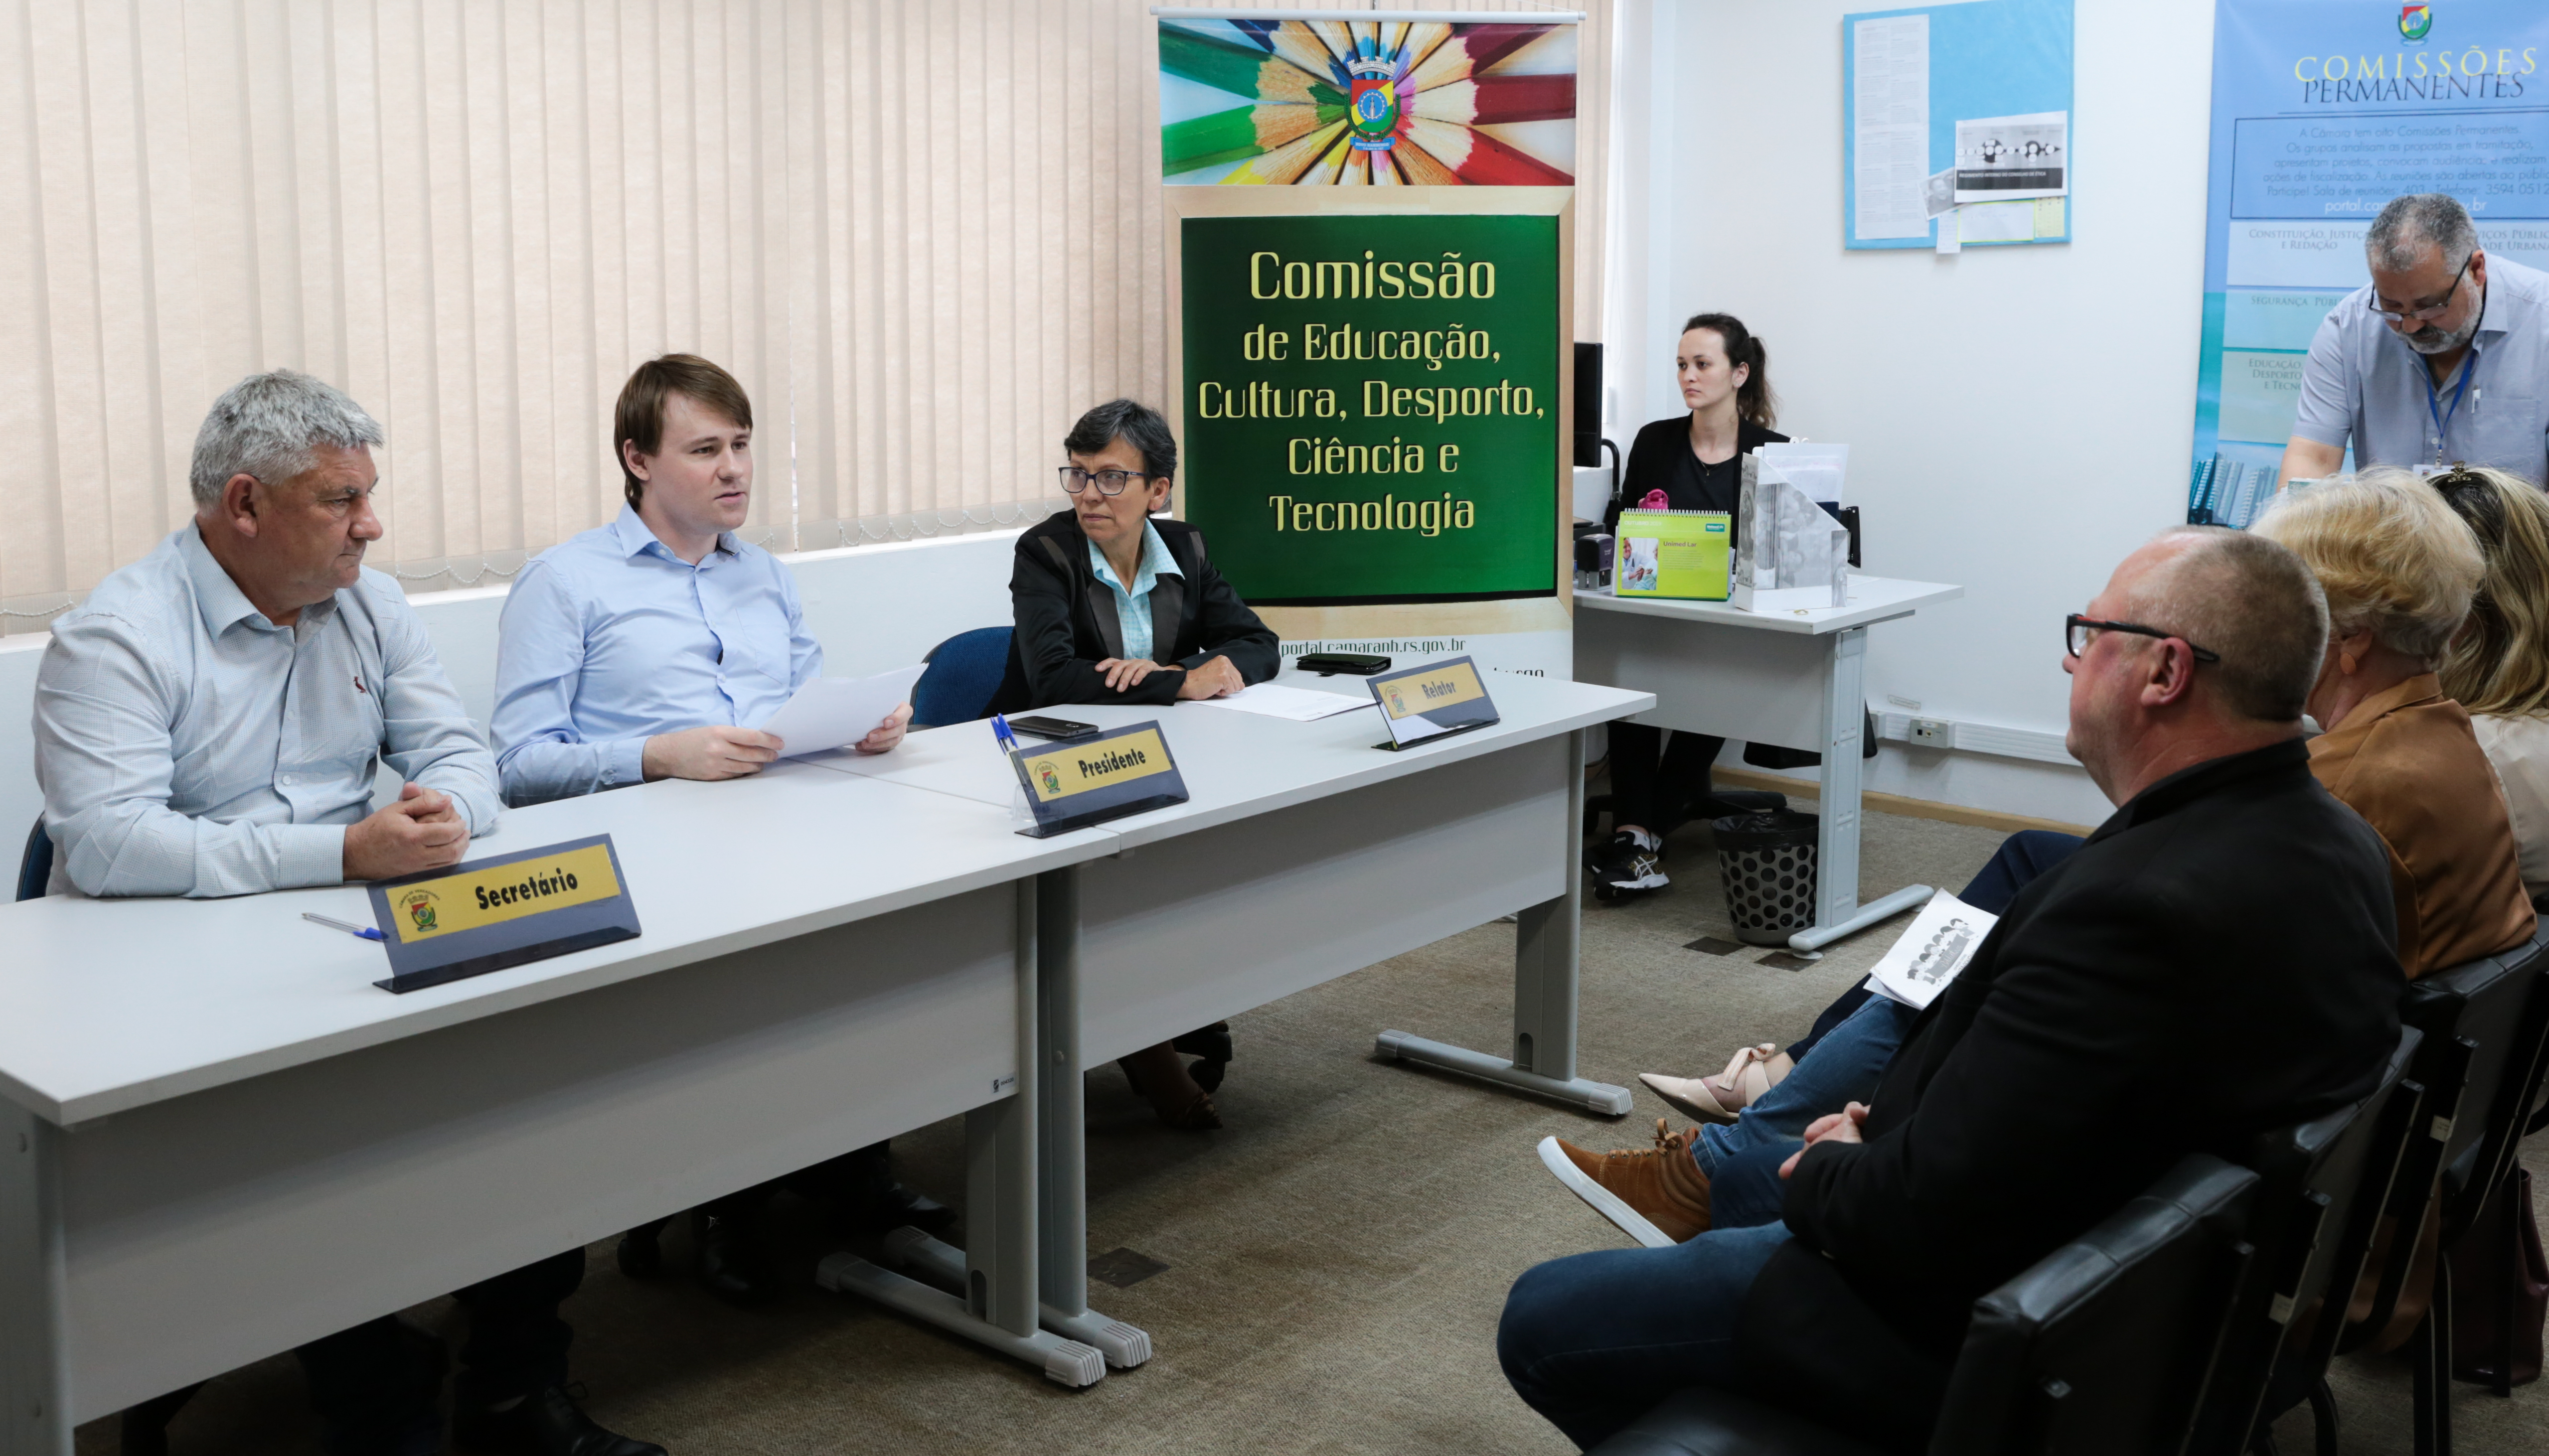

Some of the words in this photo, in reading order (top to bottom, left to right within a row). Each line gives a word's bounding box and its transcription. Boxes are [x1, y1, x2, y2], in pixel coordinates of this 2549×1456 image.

[2295, 45, 2537, 82] COMISSÕES
[2304, 71, 2526, 103] PERMANENTES
[2299, 129, 2307, 138] A
[2311, 127, 2351, 138] Câmara
[2355, 129, 2372, 137] tem
[2375, 128, 2394, 137] oito
[2397, 125, 2451, 137] Comissões
[2455, 124, 2522, 135] Permanentes.
[2274, 158, 2328, 170] apresentam
[2332, 158, 2373, 170] projetos,
[2377, 157, 2428, 166] convocam
[2502, 153, 2547, 164] realizam
[2286, 142, 2300, 153] Os
[2304, 144, 2337, 156] grupos
[2340, 141, 2385, 152] analisam
[2403, 142, 2452, 153] propostas
[2476, 140, 2534, 150] tramitação,
[2262, 173, 2291, 183] ações
[2294, 171, 2307, 181] de
[2374, 170, 2387, 181] As
[2390, 171, 2432, 180] reuniões
[2435, 171, 2454, 180] são
[2458, 168, 2496, 180] abertas
[2519, 166, 2549, 181] públic
[2267, 185, 2309, 198] Participe!
[2313, 185, 2335, 196] Sala
[2339, 185, 2352, 196] de
[2485, 183, 2514, 195] 3594
[1250, 250, 1496, 299] Comissão
[1244, 323, 1289, 361] de
[1304, 323, 1501, 371] Educação,
[1199, 381, 1347, 422] Cultura,
[1363, 379, 1545, 425] Desporto,
[1288, 437, 1425, 474] Ciência
[1439, 443, 1459, 473] e
[1269, 492, 1474, 537] Tecnologia
[1422, 681, 1457, 699] Relator
[1078, 748, 1146, 779] Presidente
[475, 868, 578, 910] Secretário
